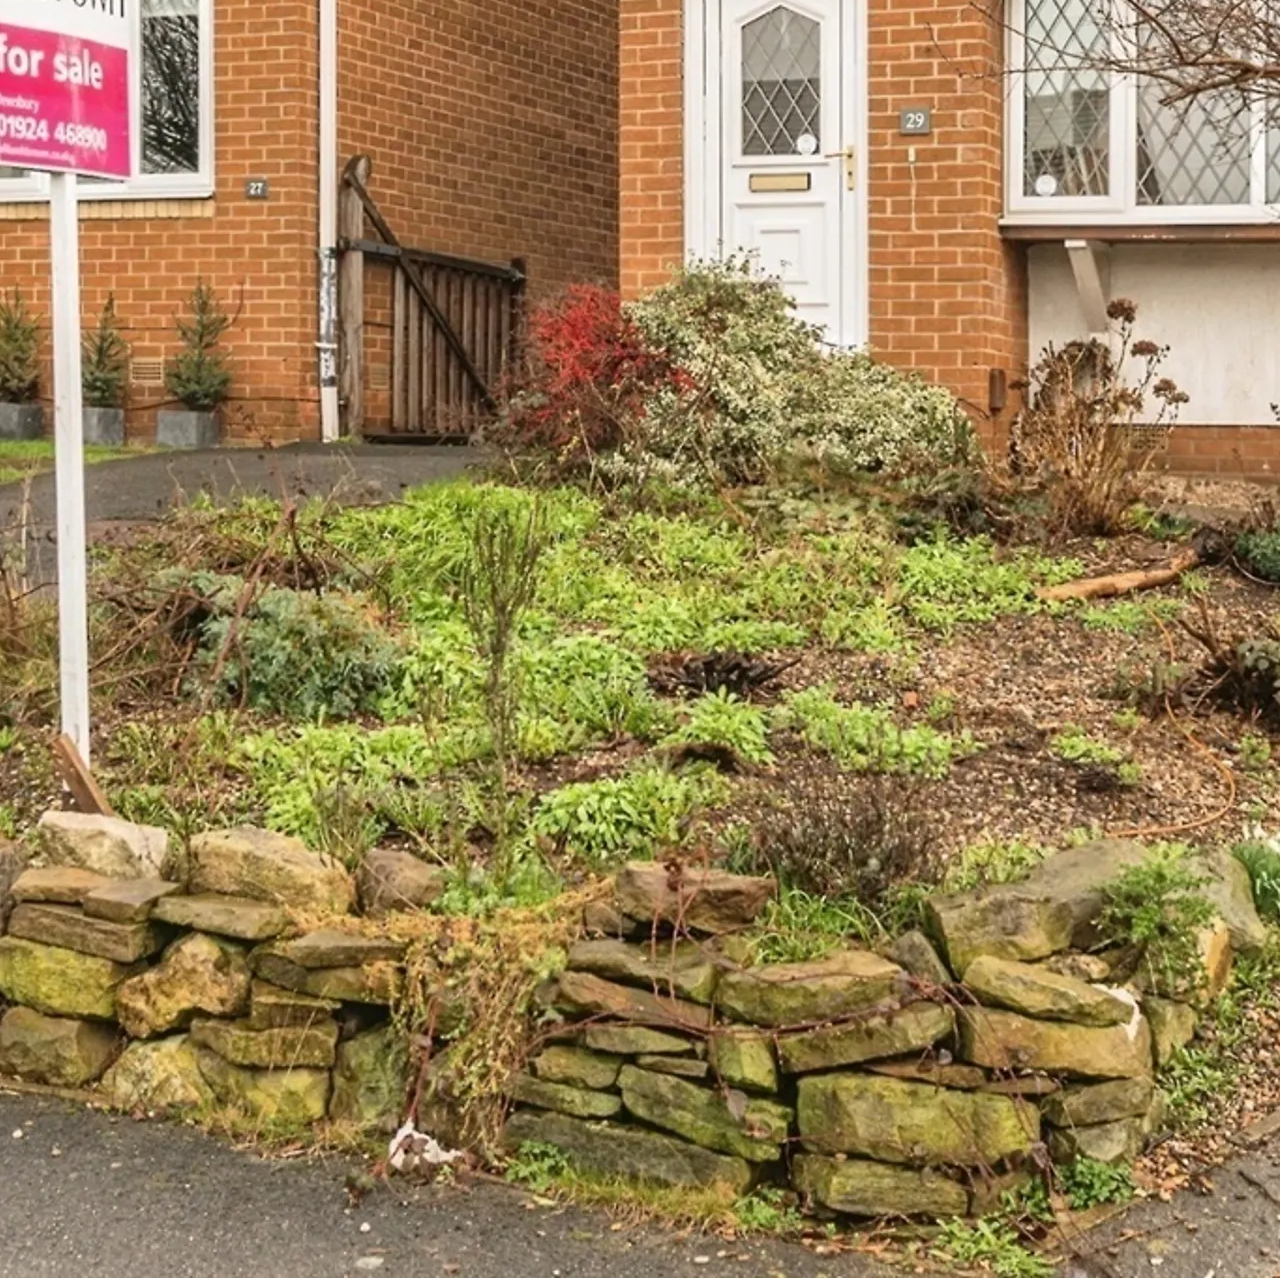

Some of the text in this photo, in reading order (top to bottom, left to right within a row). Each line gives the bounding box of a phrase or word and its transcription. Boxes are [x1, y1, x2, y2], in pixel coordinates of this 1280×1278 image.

[53, 49, 104, 89] sale
[906, 112, 924, 129] 29
[249, 182, 264, 195] 27
